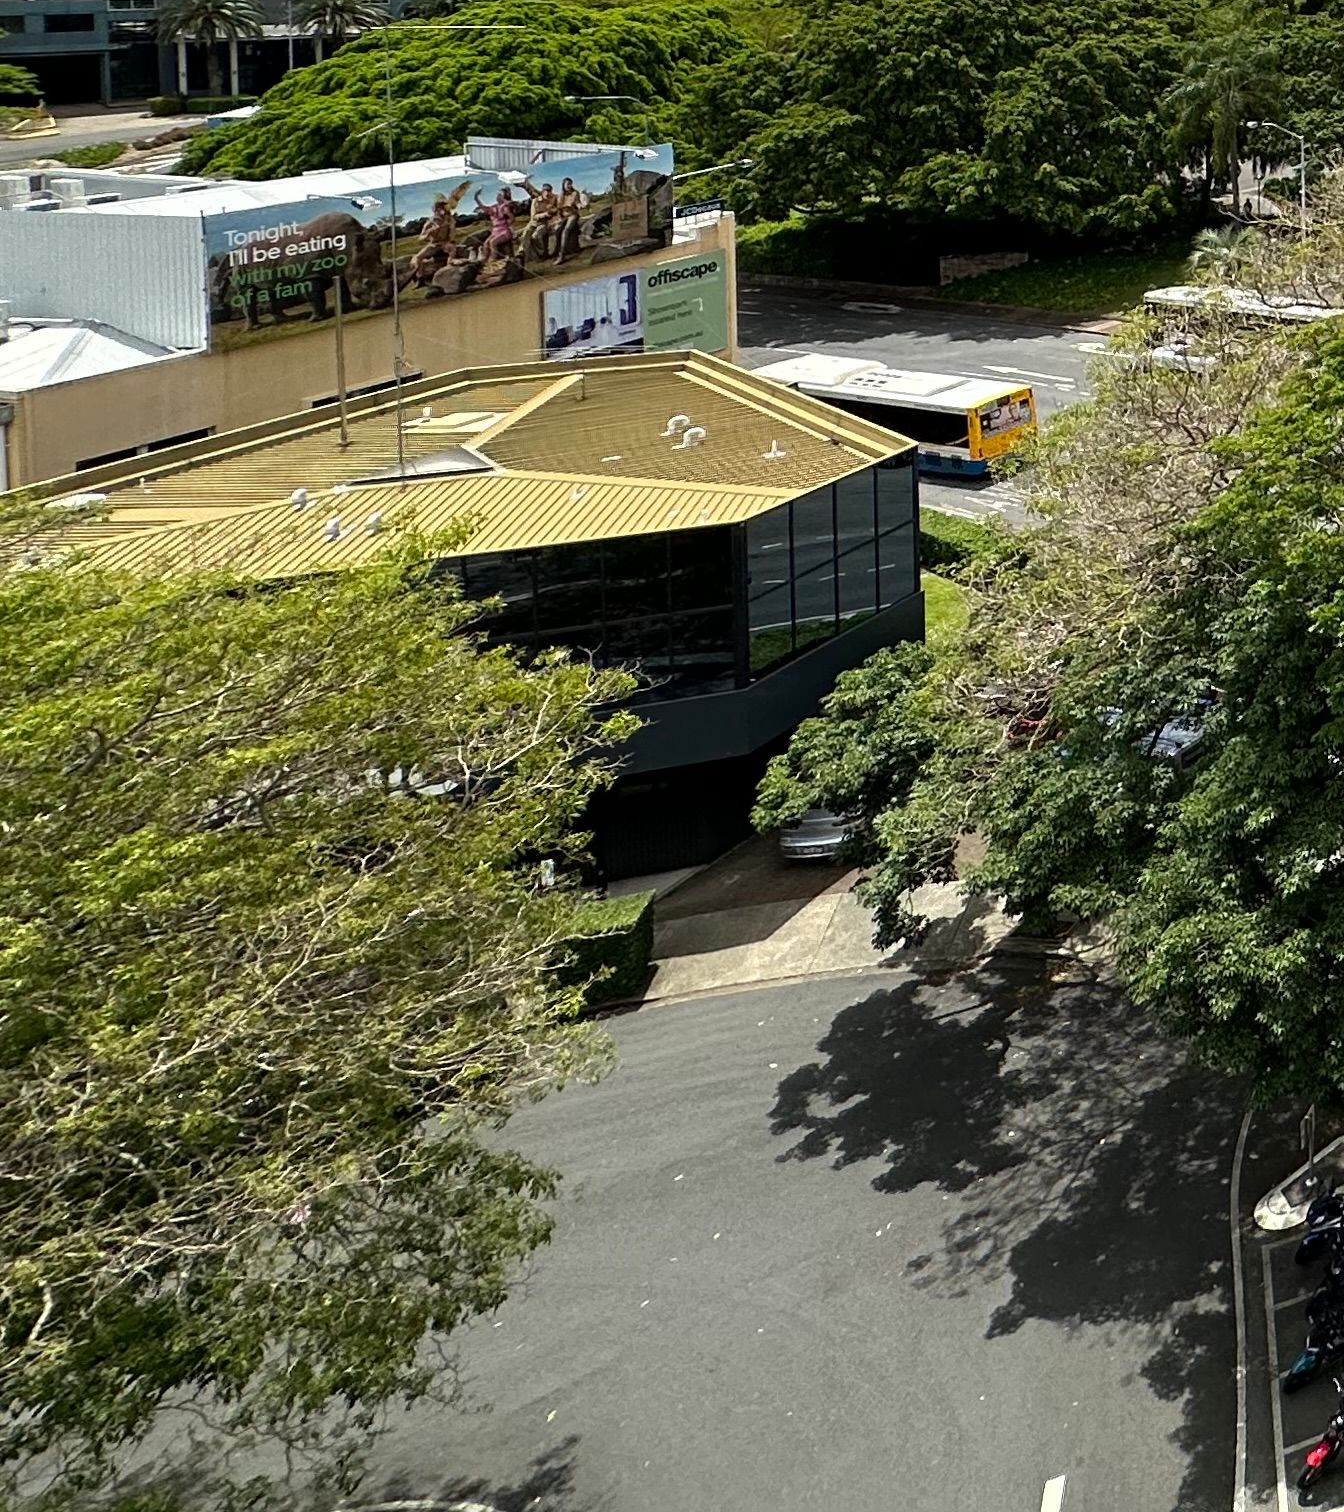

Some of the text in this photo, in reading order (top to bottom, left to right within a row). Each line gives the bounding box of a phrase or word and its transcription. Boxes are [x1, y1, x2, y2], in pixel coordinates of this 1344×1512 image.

[224, 221, 304, 247] Tonight,
[228, 234, 347, 267] I'll be eating
[228, 254, 348, 287] with my zoo
[230, 280, 313, 308] of a fam
